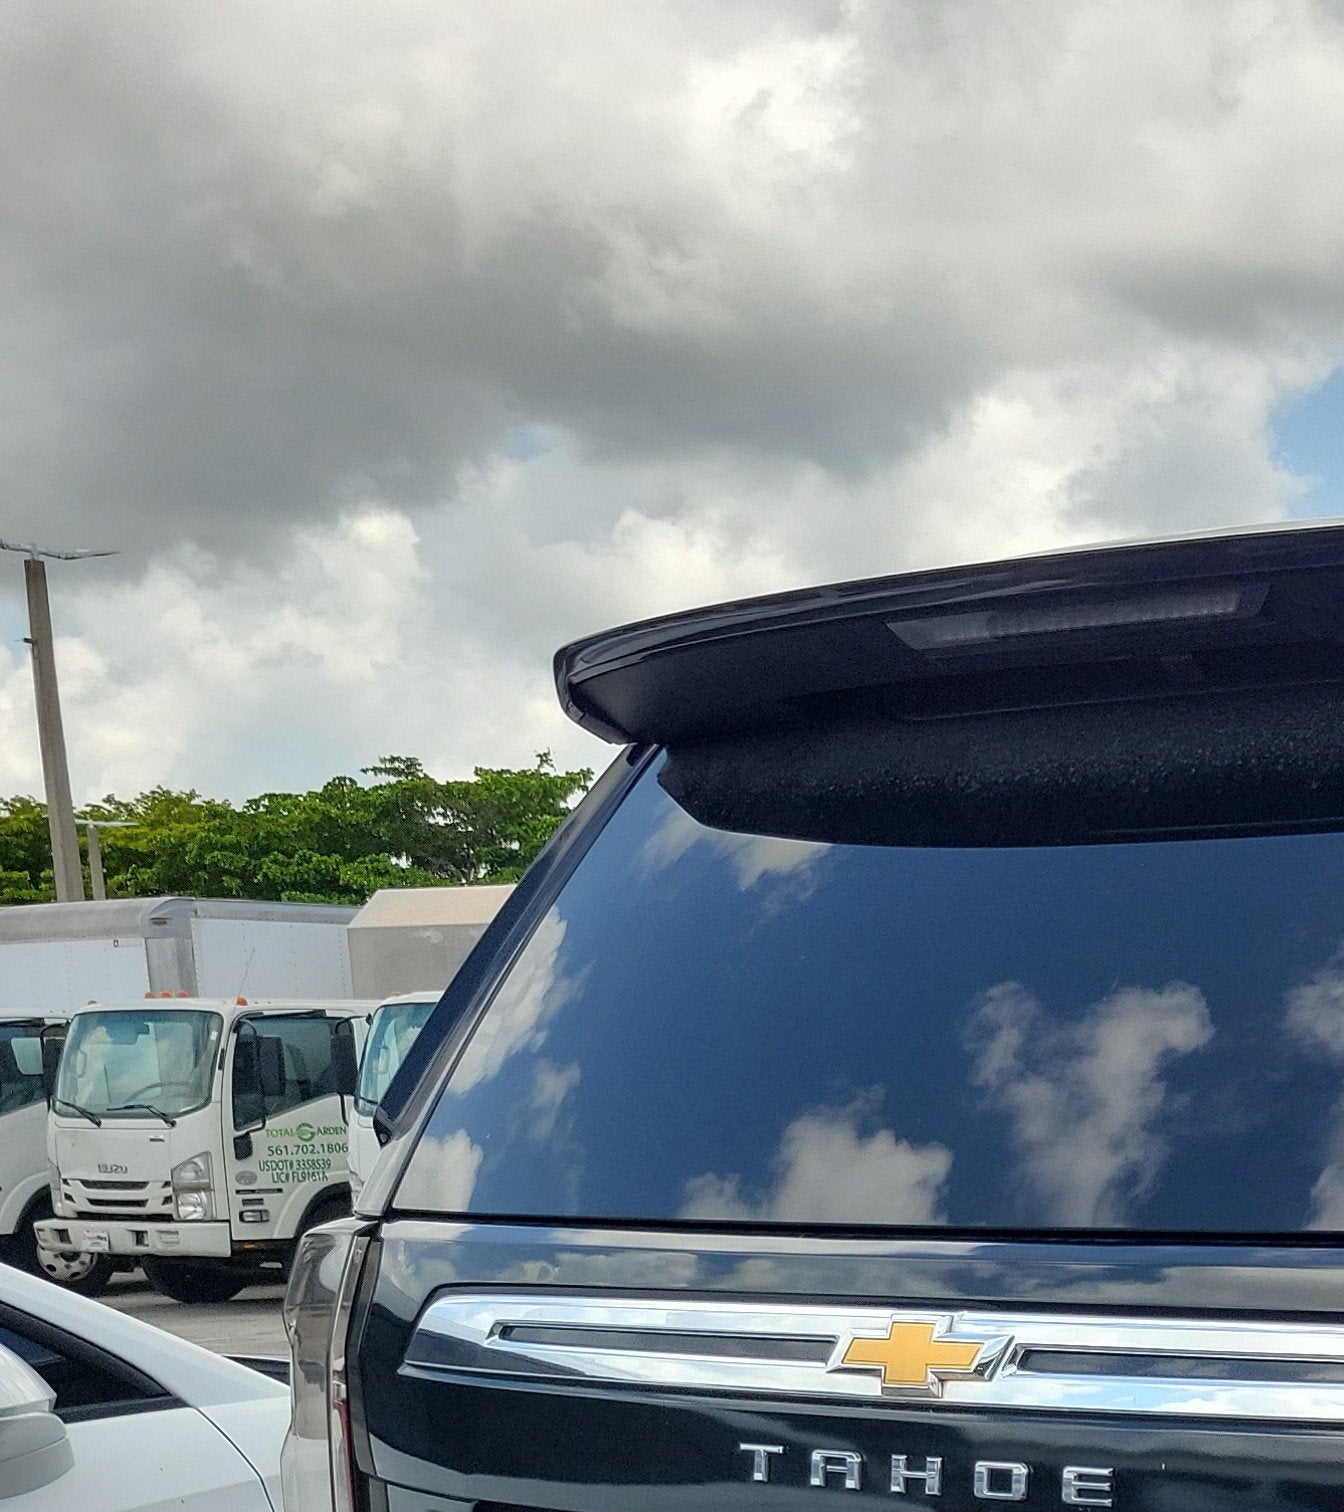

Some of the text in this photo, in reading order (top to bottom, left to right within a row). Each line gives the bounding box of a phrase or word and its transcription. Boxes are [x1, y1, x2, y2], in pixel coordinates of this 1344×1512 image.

[265, 1128, 294, 1138] TOTAL
[267, 1143, 349, 1157] 561.702.1806
[738, 1441, 1118, 1508] TAHOE
